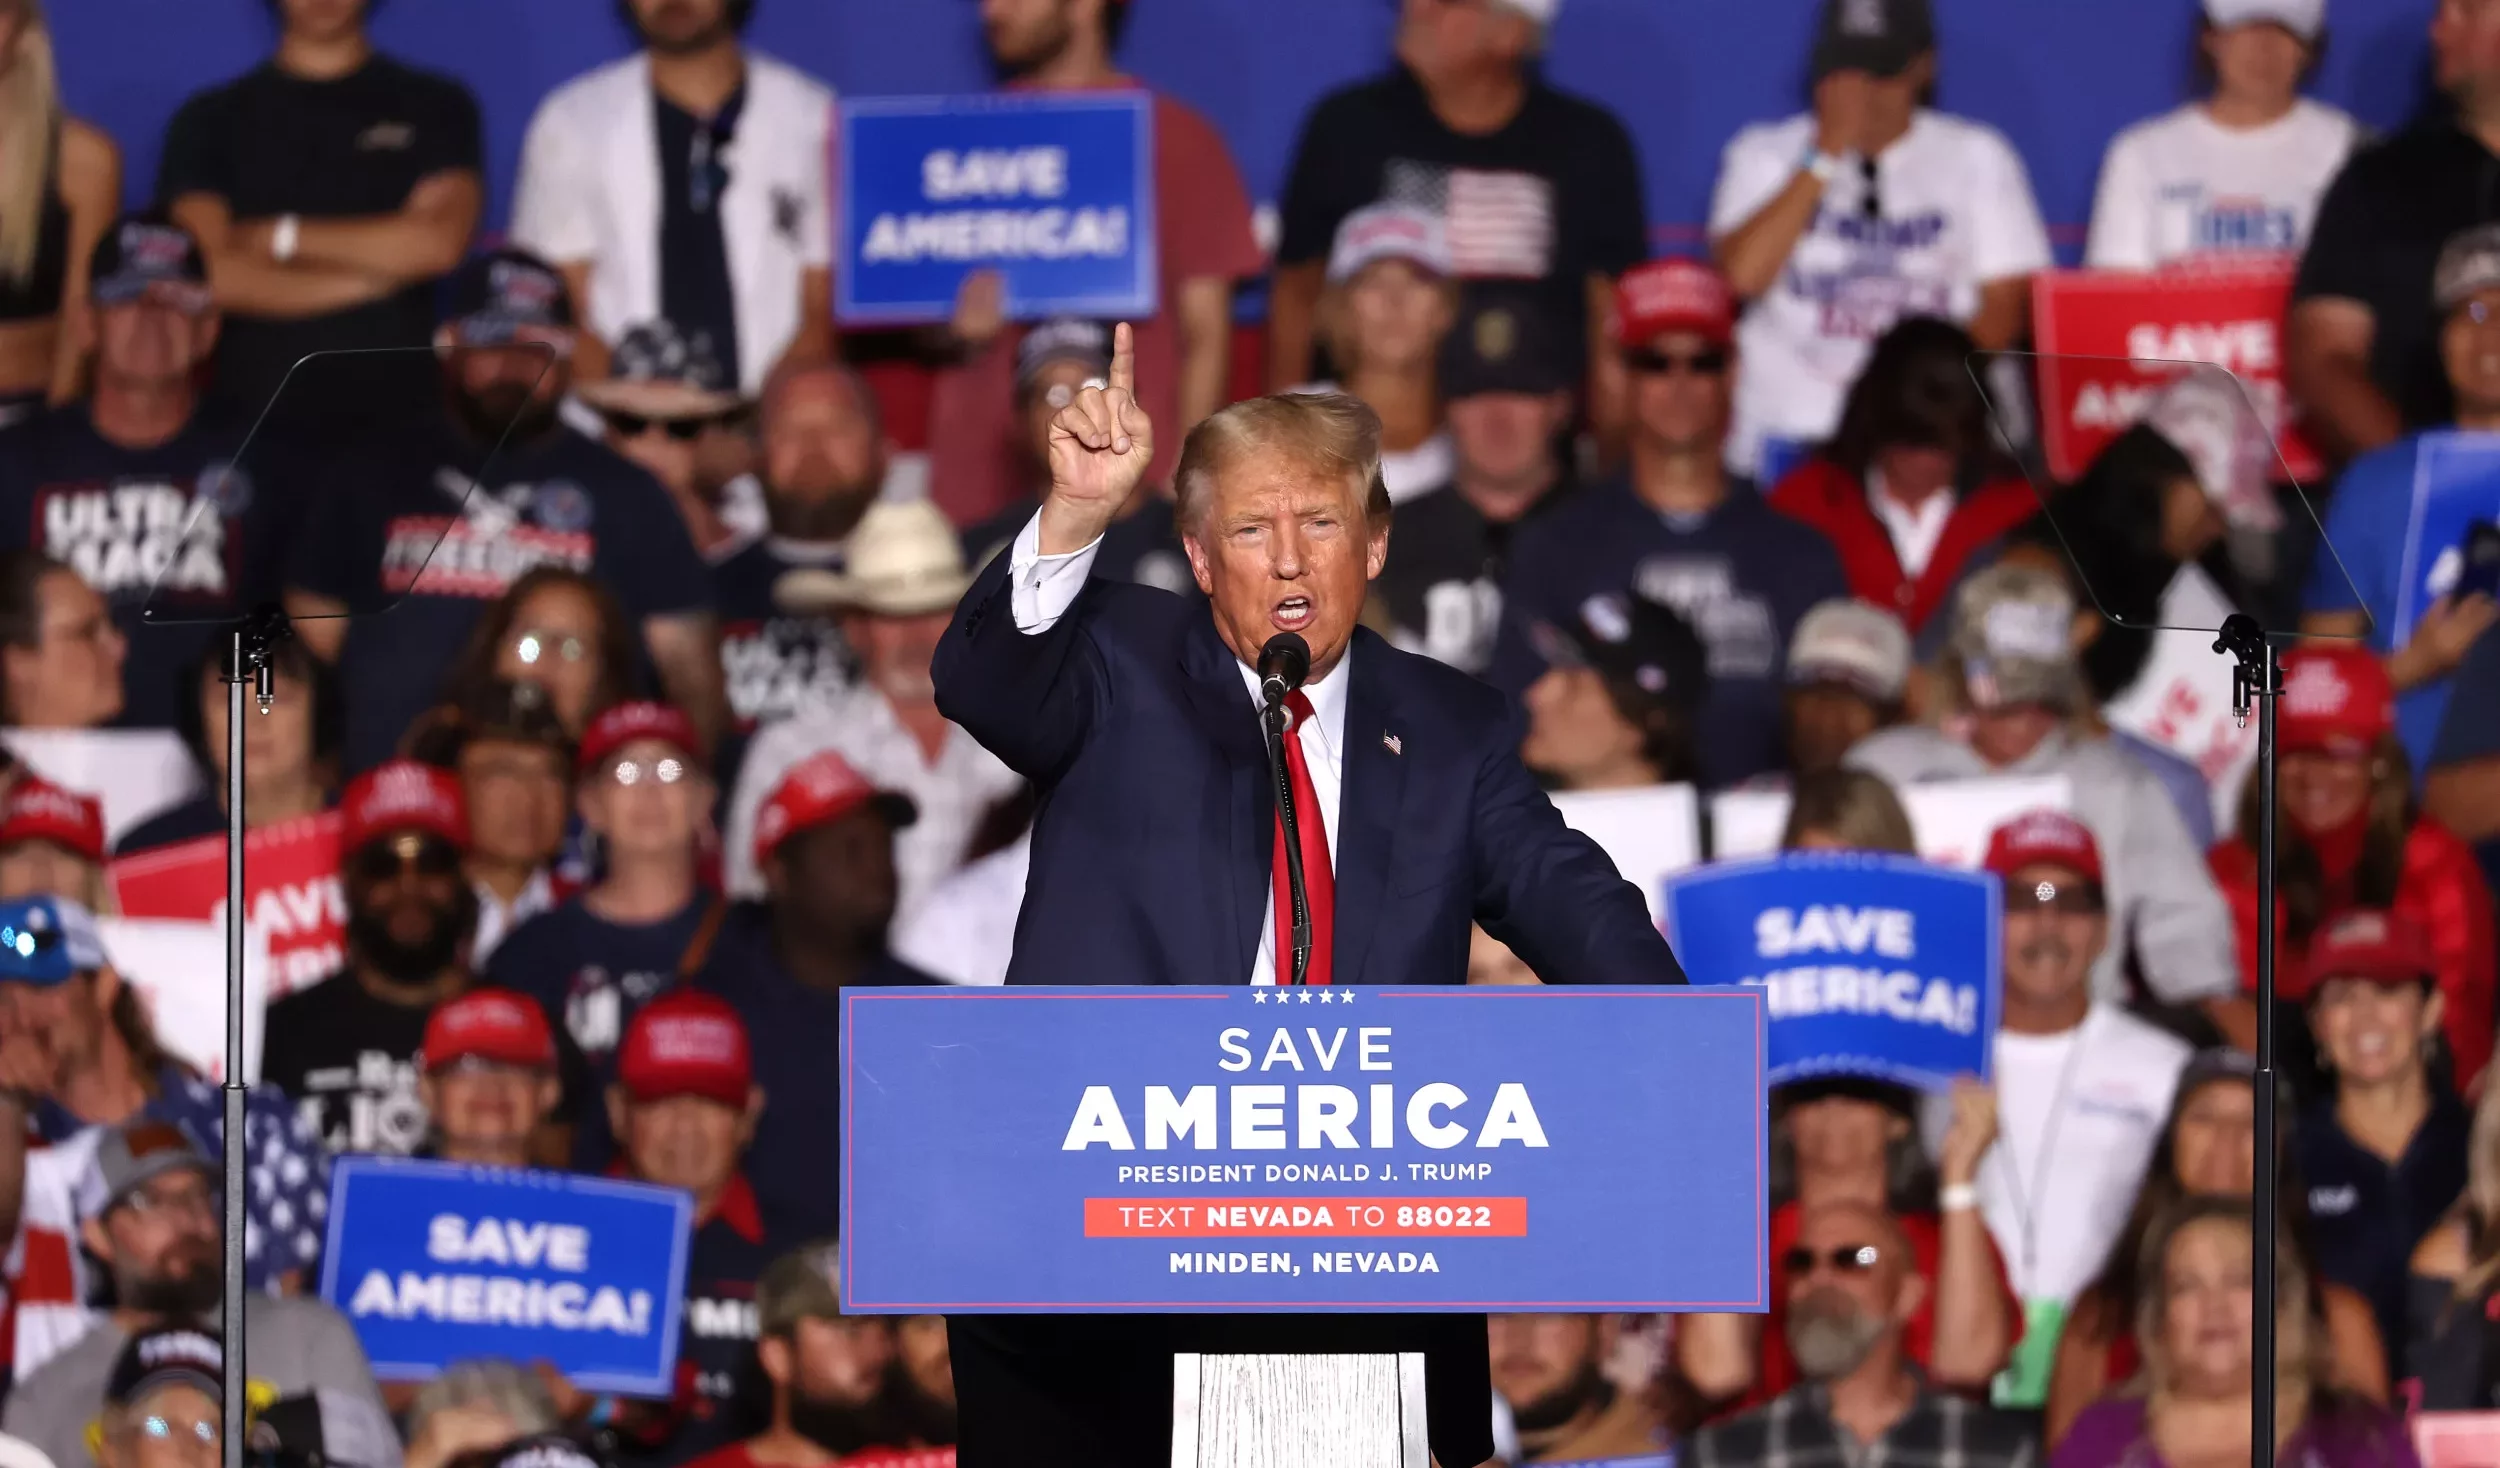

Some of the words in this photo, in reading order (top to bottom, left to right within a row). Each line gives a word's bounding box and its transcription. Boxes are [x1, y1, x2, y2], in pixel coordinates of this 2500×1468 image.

[922, 146, 1067, 201] SAVE
[863, 206, 1128, 262] AMERICA!
[2127, 320, 2276, 373] SAVE
[1755, 905, 1915, 959] SAVE
[1740, 965, 1977, 1036] MERICA!
[1219, 1028, 1392, 1072] SAVE
[1062, 1083, 1549, 1151] AMERICA
[1118, 1164, 1256, 1183] PRESIDENT
[1265, 1164, 1370, 1182] DONALD
[1379, 1163, 1398, 1182] J.
[1408, 1163, 1492, 1181] TRUMP
[428, 1214, 588, 1271] SAVE
[1119, 1207, 1195, 1228] TEXT
[1207, 1206, 1334, 1228] NEVADA
[1345, 1206, 1385, 1227] TO
[1397, 1206, 1491, 1227] 88022
[1170, 1252, 1301, 1277] MINDEN,
[1313, 1252, 1440, 1273] NEVADA
[352, 1270, 651, 1337] AMERICA!
